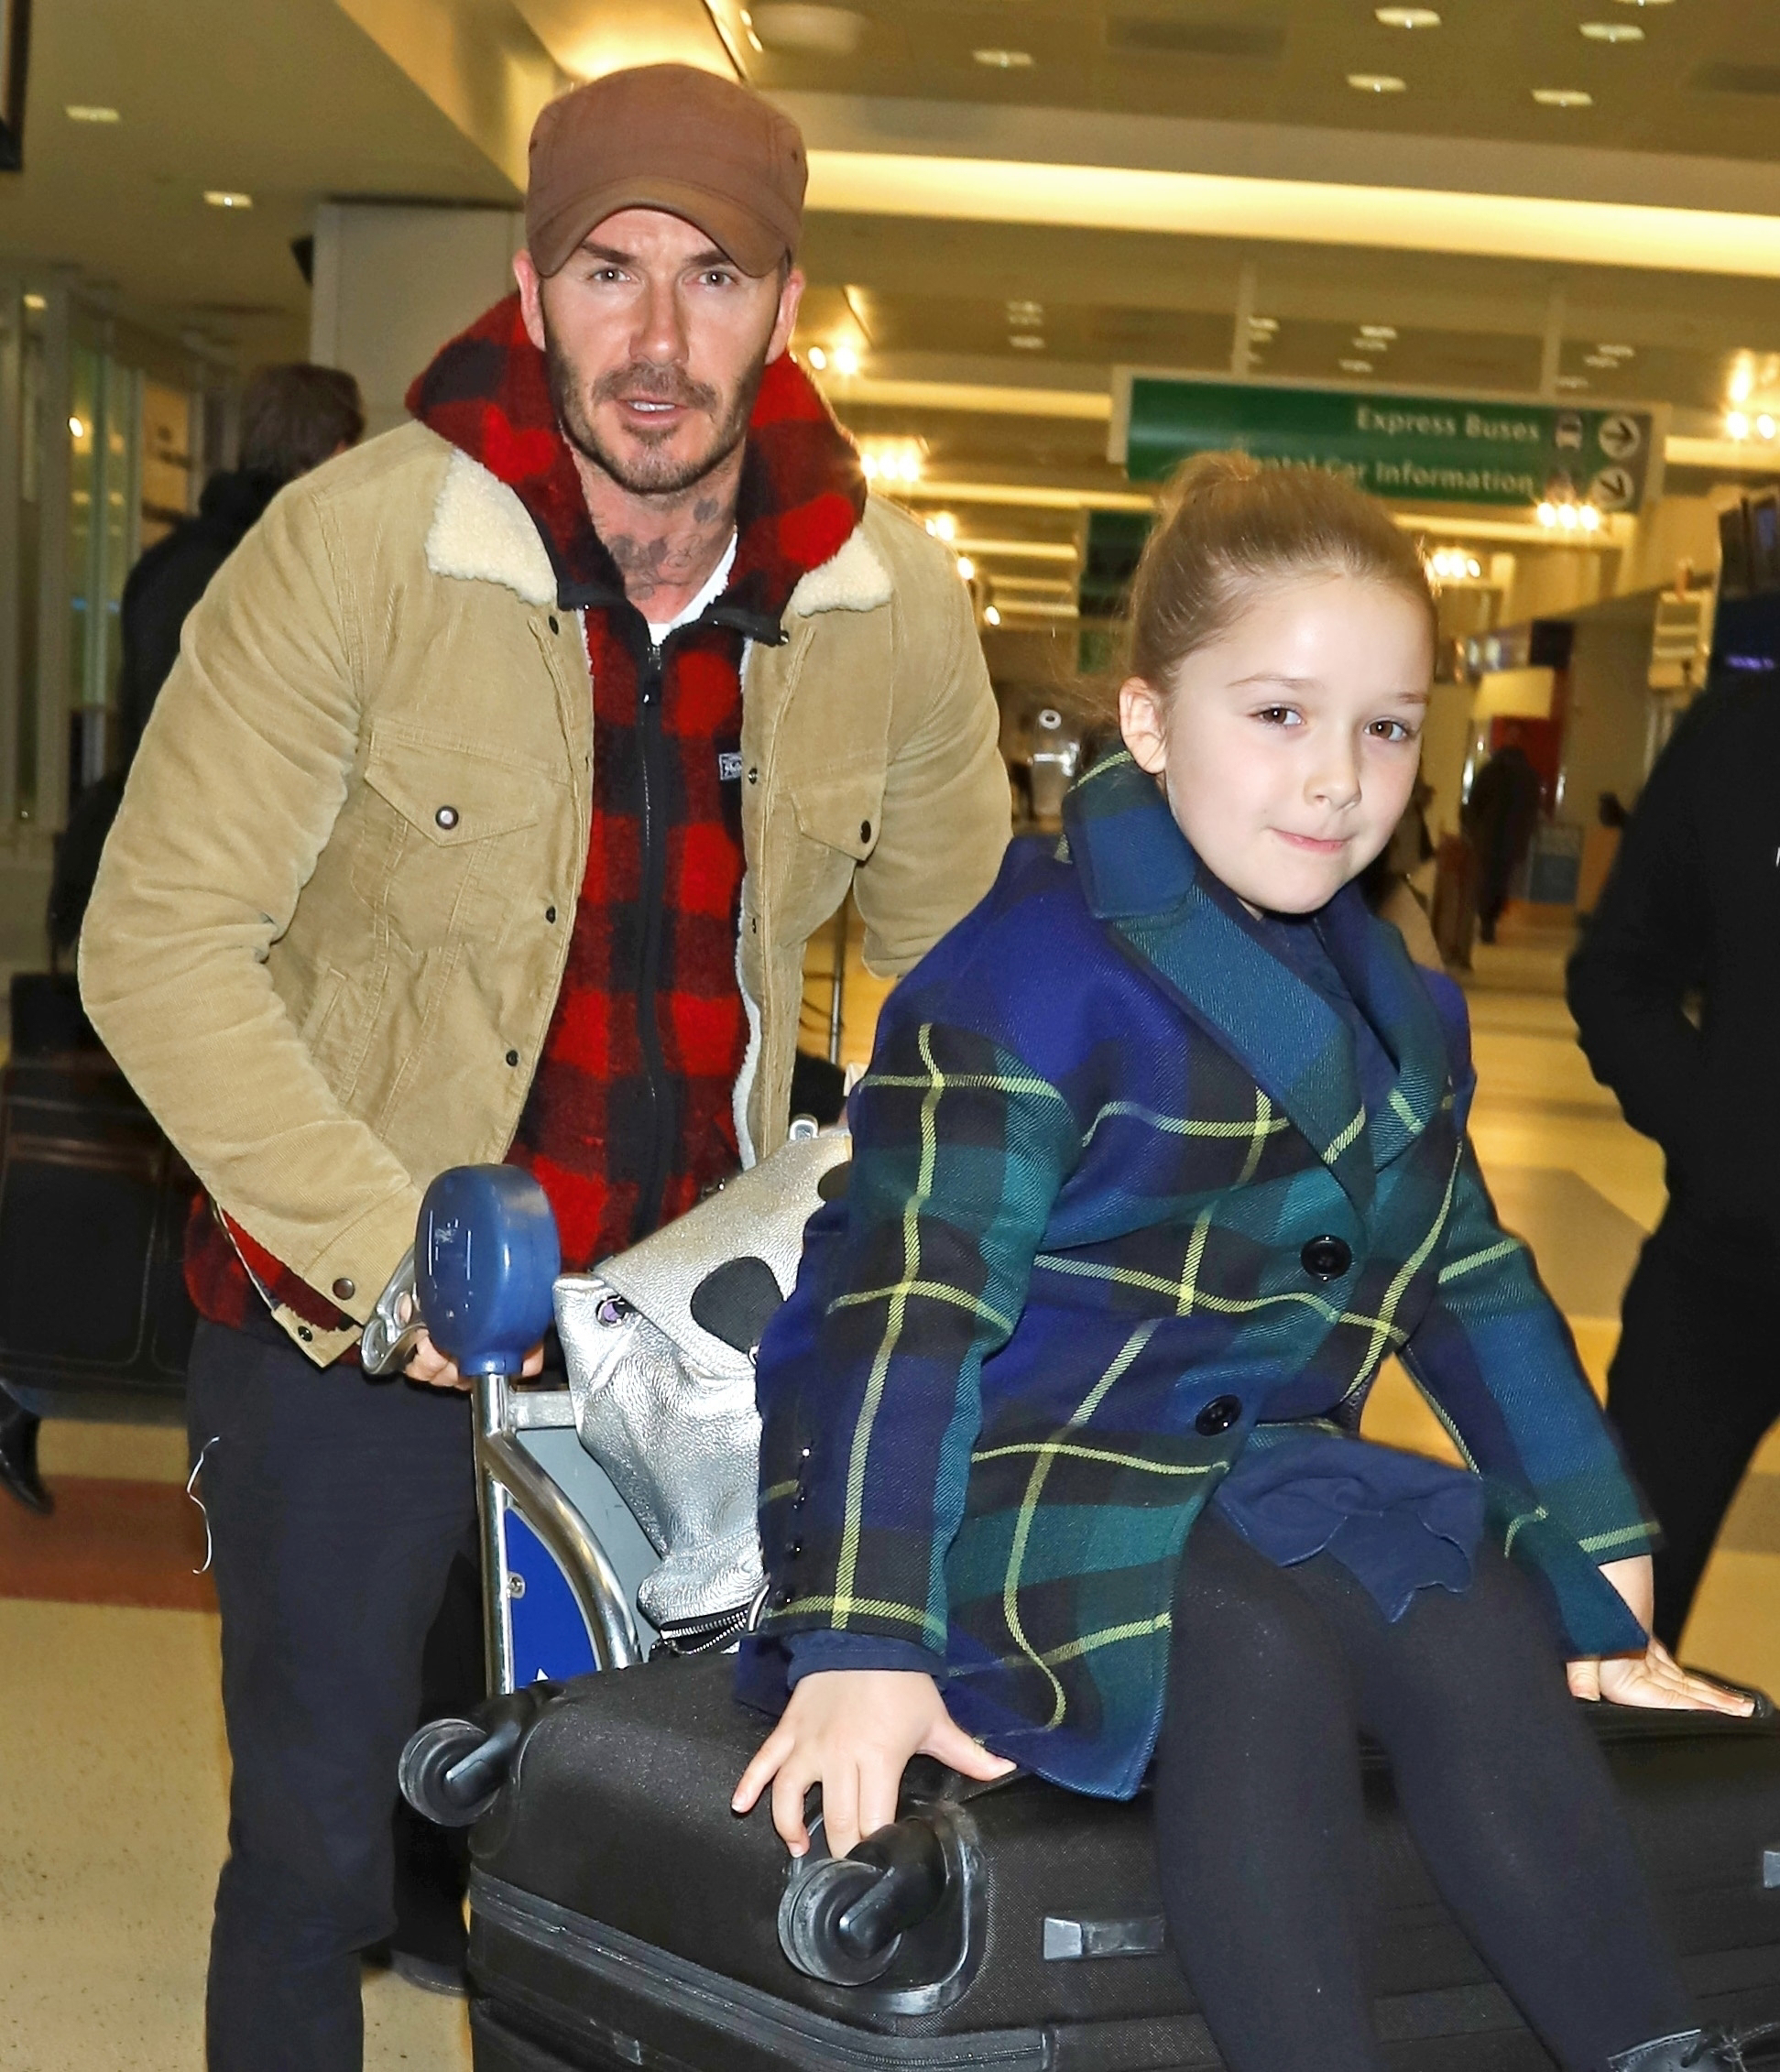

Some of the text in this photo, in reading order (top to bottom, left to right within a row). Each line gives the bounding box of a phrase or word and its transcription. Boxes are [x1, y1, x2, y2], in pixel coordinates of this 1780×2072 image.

[1357, 404, 1540, 442] Express Buses
[1376, 460, 1534, 495] Information
